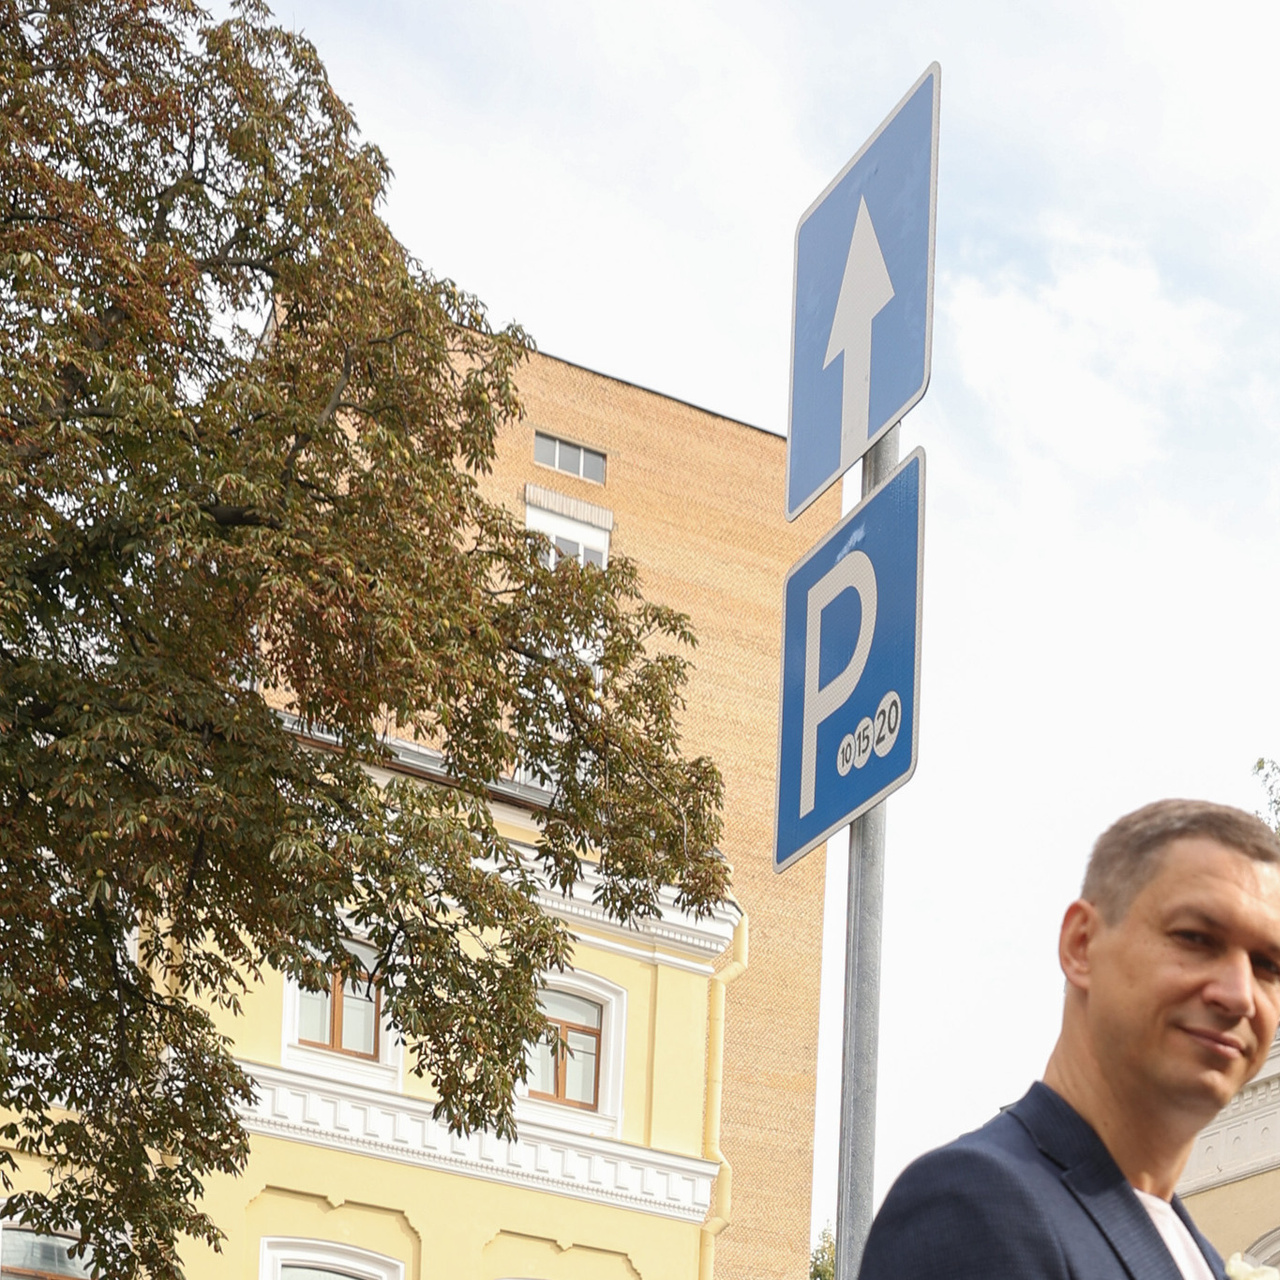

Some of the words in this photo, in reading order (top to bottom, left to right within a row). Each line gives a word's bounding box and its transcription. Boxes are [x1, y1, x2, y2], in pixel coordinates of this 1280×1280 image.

[799, 550, 878, 819] P
[840, 742, 852, 768] 10
[857, 724, 870, 757] 15
[875, 699, 899, 746] 20
